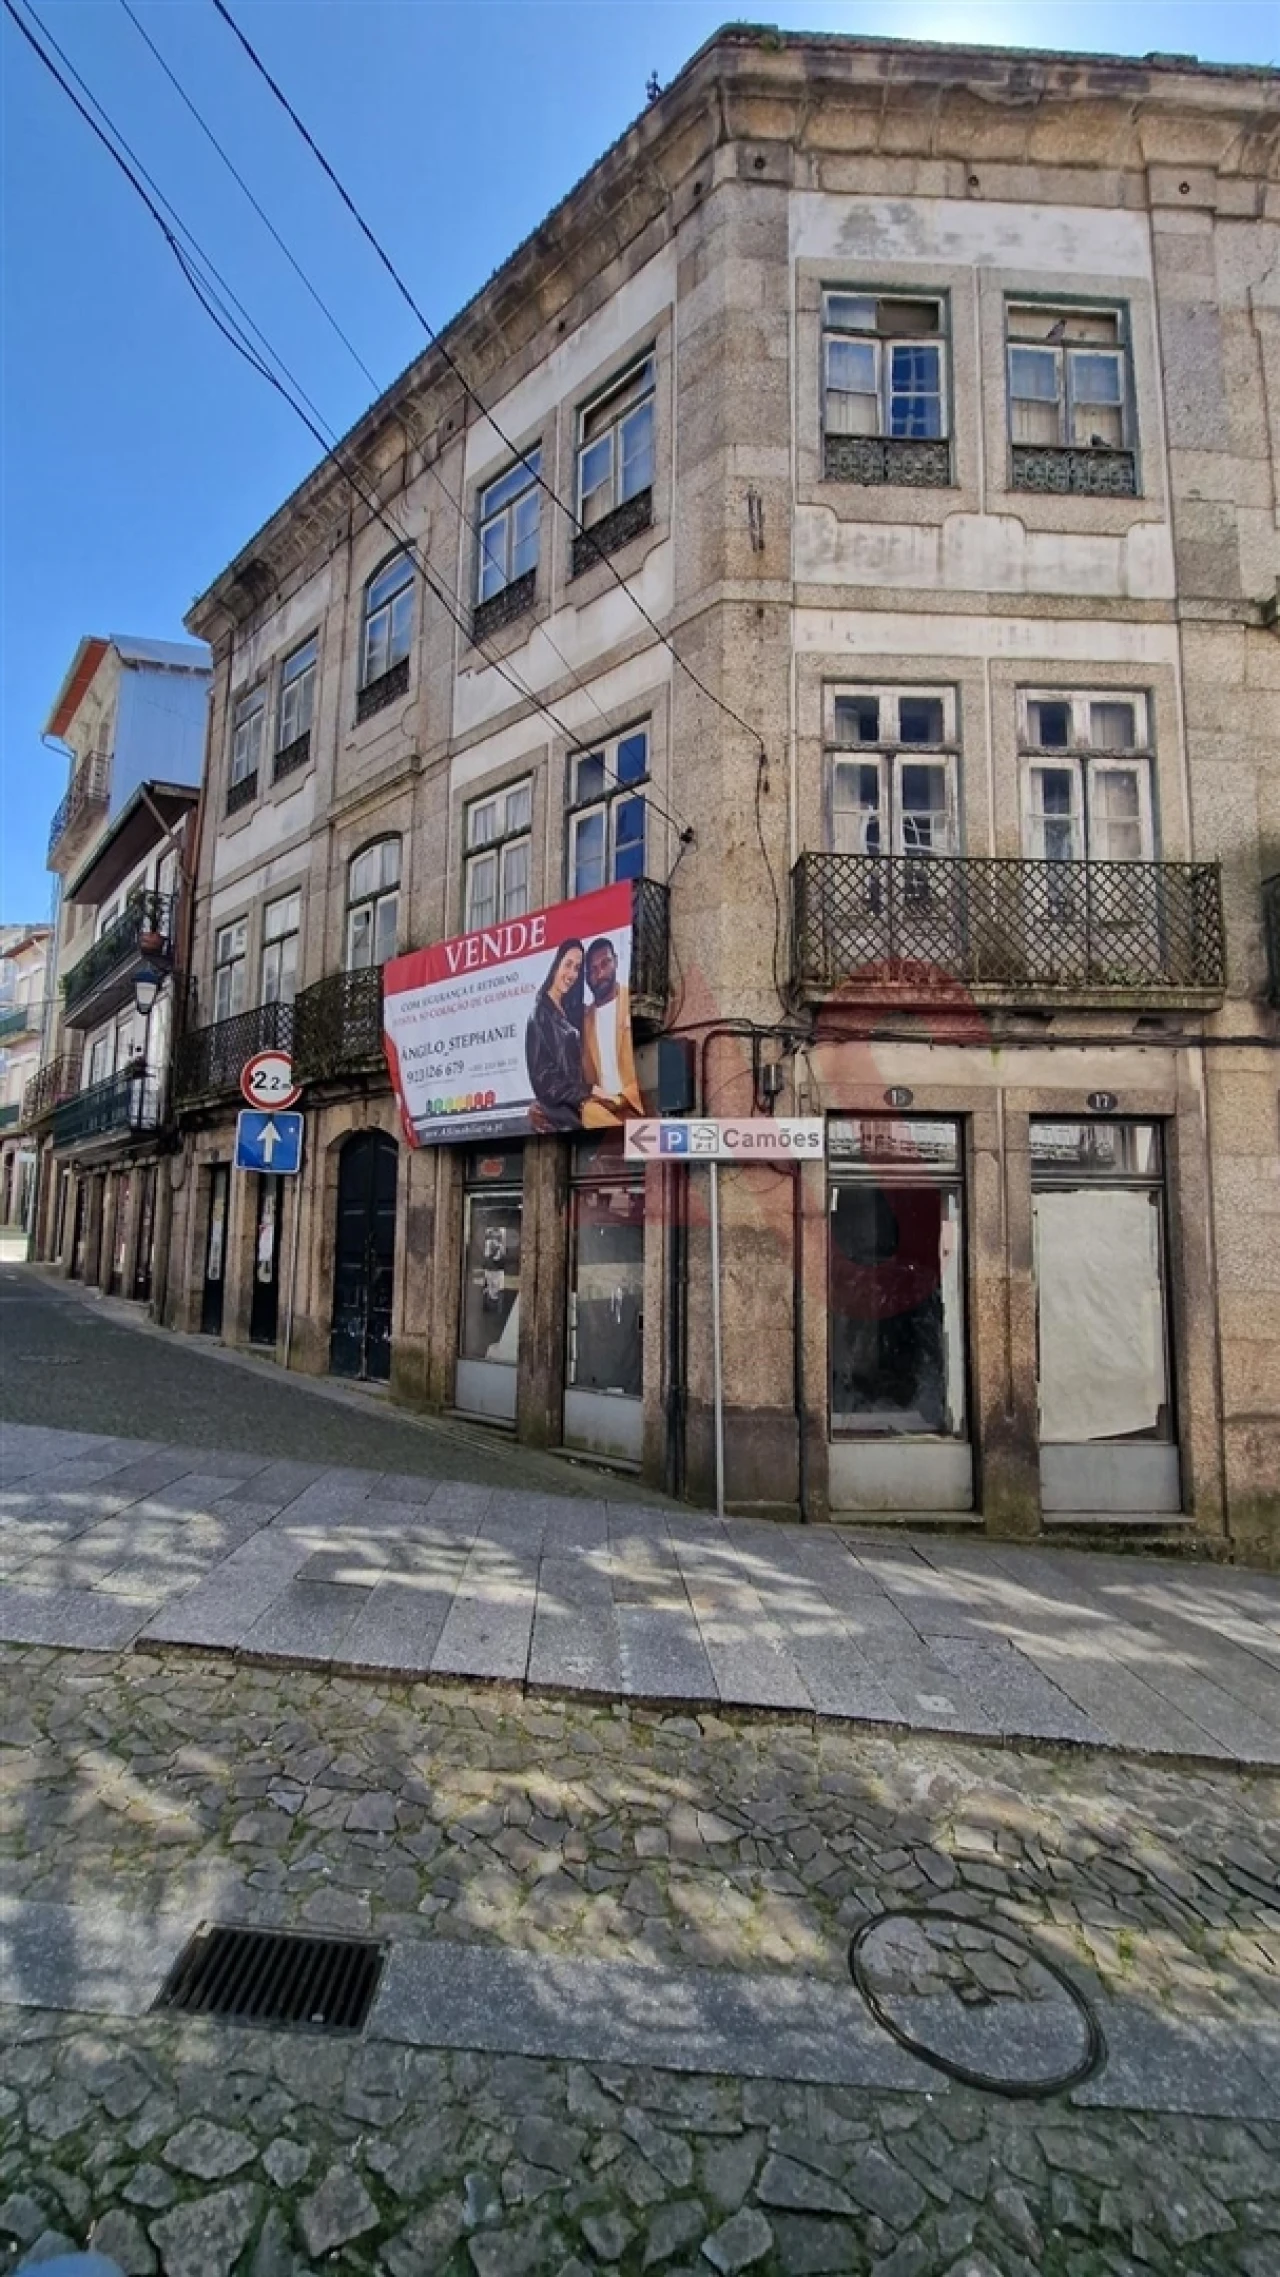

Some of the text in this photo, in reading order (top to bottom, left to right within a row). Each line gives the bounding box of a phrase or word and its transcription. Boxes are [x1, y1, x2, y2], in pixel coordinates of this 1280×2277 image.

[445, 916, 547, 973] VENDE
[1095, 1094, 1109, 1108] 17
[667, 1128, 819, 1150] P Camões
